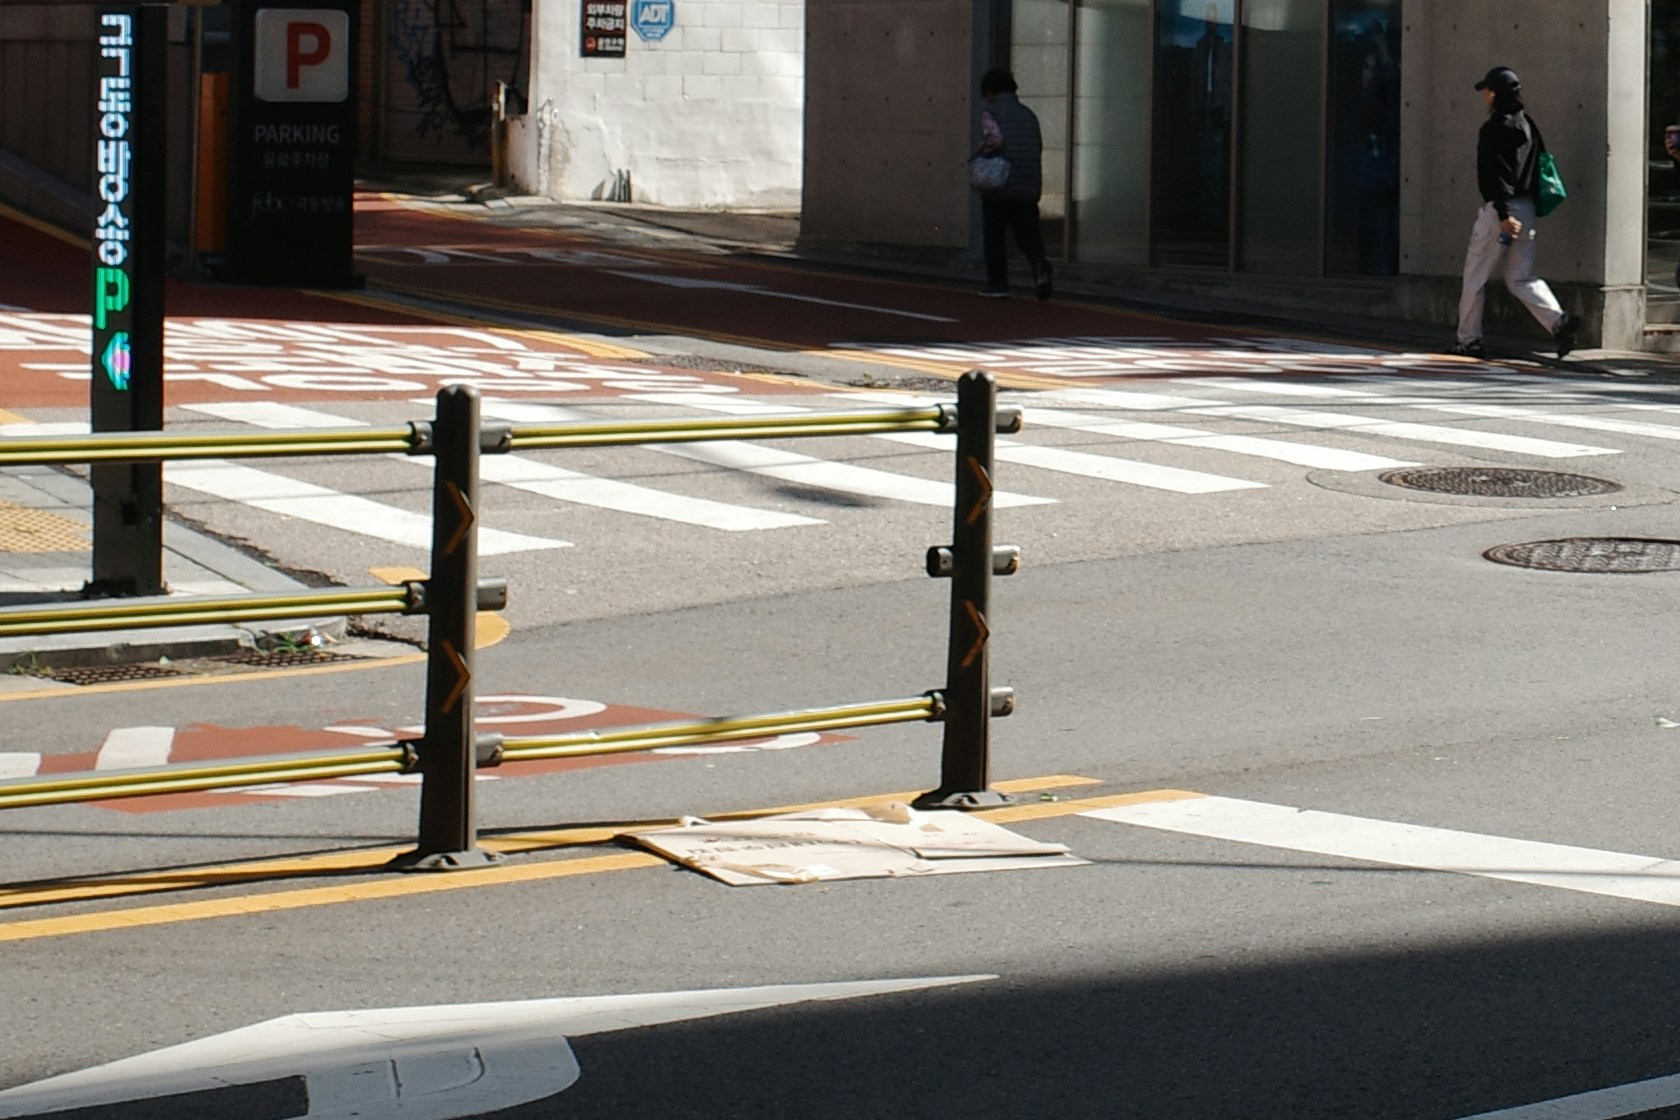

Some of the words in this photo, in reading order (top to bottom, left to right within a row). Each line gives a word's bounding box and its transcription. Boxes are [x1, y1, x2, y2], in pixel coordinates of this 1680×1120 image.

[640, 5, 668, 24] ADT
[286, 22, 330, 88] P
[96, 12, 133, 266] 극동방송
[255, 124, 340, 144] PARKING
[263, 150, 330, 169] 유료주차장
